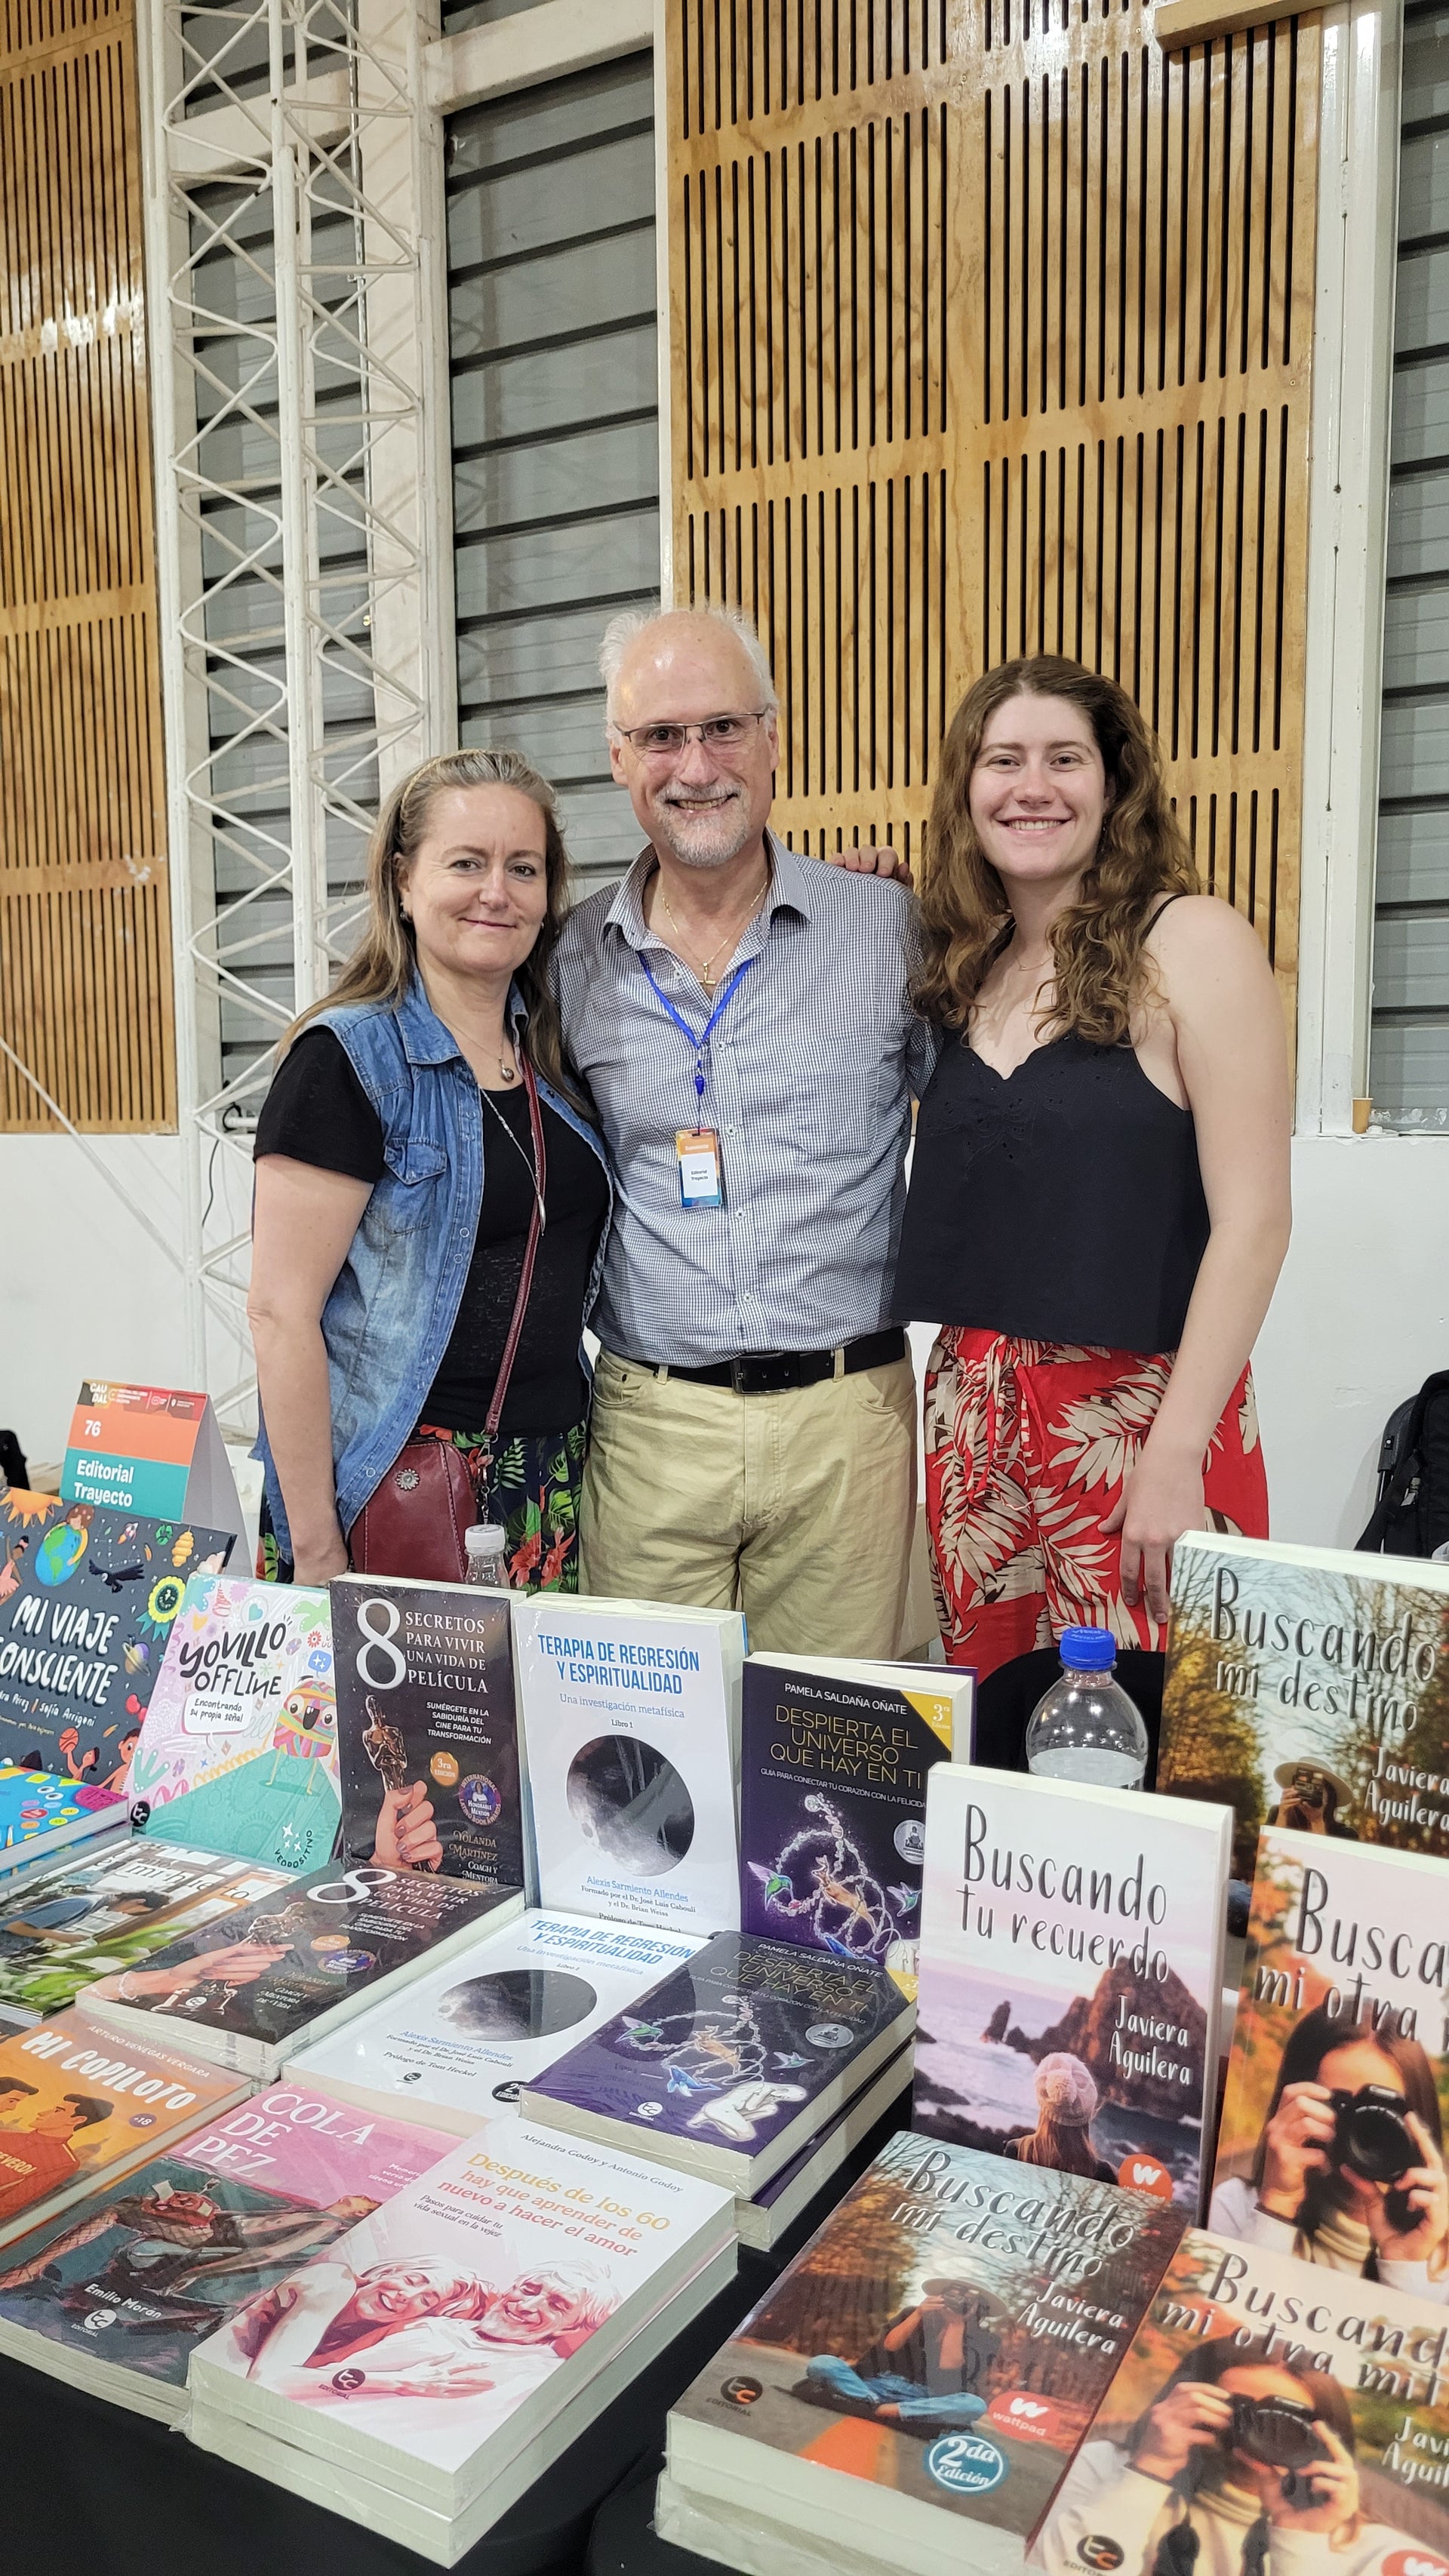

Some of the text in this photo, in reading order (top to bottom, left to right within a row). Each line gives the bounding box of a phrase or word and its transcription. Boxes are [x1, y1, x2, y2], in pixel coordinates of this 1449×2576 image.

[90, 1383, 107, 1393] CAU
[91, 1393, 108, 1404] DAL
[84, 1420, 101, 1437] 76
[76, 1459, 134, 1484] Editorial
[73, 1482, 133, 1508] Trayecto
[11, 1594, 119, 1655] MI VIAJE
[405, 1611, 485, 1635] SECRETOS
[1211, 1566, 1437, 1682] Buscando
[356, 1598, 406, 1690] 8
[406, 1632, 485, 1654] PARA VIVIR
[537, 1634, 700, 1672] TERAPIA DE REGRESIÓN
[0, 1636, 118, 1705] ONSCIENTE
[406, 1650, 486, 1671] UNA VIDA DE
[556, 1660, 682, 1694] Y ESPIRITUALIDAD
[408, 1669, 489, 1694] PELÍCULA
[1216, 1660, 1418, 1737] mi destino
[189, 1708, 244, 1723] su propia señal
[194, 1697, 242, 1713] Encontrando
[426, 1701, 489, 1717] SUMÉRGETE EN LA
[559, 1694, 685, 1719] Una investigación metafísica
[784, 1682, 908, 1716] PAMELA SALDAÑA OÑATE
[62, 1707, 97, 1729] Arrigoni
[432, 1711, 485, 1725] SABIDURÍA DEL
[435, 1721, 482, 1734] CINE PARA TU
[611, 1719, 628, 1728] Libro
[776, 1705, 918, 1750] DESPIERTA EL
[427, 1728, 491, 1744] TRANSFORMACIÓN
[791, 1727, 899, 1765] UNIVERSO
[437, 1758, 451, 1769] 3ra
[770, 1743, 921, 1790] QUE HAY EN TI
[1372, 1746, 1449, 1795] Javiera
[1364, 1780, 1449, 1831] Aguilera
[449, 1843, 498, 1861] MARTÍNEZ
[453, 1830, 497, 1848] YOLANDA
[462, 1870, 499, 1885] MENTORA
[468, 1860, 492, 1872] COACH
[963, 1803, 1167, 1925] Buscando
[306, 1868, 398, 1904] 8
[371, 1890, 460, 1911] UNA VIDA DE
[383, 1885, 469, 1905] PARA VIVIR
[395, 1877, 483, 1898] SECRETOS
[358, 1897, 447, 1920] PELÍCULA
[530, 1919, 697, 1959] TERAPIA DE REGRESIÓN
[533, 1932, 663, 1965] Y ESPIRITUALIDAD
[956, 1883, 1169, 1983] tu recuerdo
[733, 1950, 878, 1995] DESPIERTA EL
[758, 1943, 884, 1978] PAMELA SALDAÑA OÑATE
[710, 1966, 868, 2012] QUE HAY EN TI
[742, 1963, 854, 1996] UNIVERSO
[1254, 1965, 1417, 2041] mi otra
[1115, 1994, 1189, 2048] Javiera
[88, 2025, 211, 2079] ARTURO VENEGAS VERGARA
[1109, 2030, 1192, 2086] Aguilera
[21, 2031, 196, 2110] MI COPILOTO
[134, 2115, 152, 2127] +18
[219, 2112, 293, 2147] DE
[261, 2092, 379, 2147] COLA
[183, 2134, 278, 2178] PEZ
[520, 2132, 567, 2153] Alejandra
[568, 2149, 599, 2165] Godoy
[608, 2162, 649, 2181] Antonio
[649, 2176, 684, 2193] Godoy
[459, 2169, 643, 2242] hay que aprender de
[466, 2152, 672, 2232] Después de los 60
[904, 2150, 1136, 2248] Buscando
[414, 2202, 431, 2212] vida
[430, 2208, 460, 2222] sexual
[469, 2221, 479, 2230] la
[480, 2227, 502, 2238] vejez
[420, 2194, 445, 2208] Pasos
[443, 2204, 464, 2215] para
[465, 2212, 493, 2225] cuidar
[437, 2181, 638, 2257] nuevo a hacer el amor
[891, 2202, 1104, 2283] mi destino
[84, 2282, 163, 2319] Emilio Morán
[1037, 2280, 1124, 2328] Javiera
[71, 2323, 100, 2338] EDITORIAL
[1017, 2303, 1117, 2355] Aguilera
[1161, 2302, 1335, 2375] mi otra
[318, 2384, 351, 2400] EDITORIAL
[706, 2396, 752, 2417] EDITORIAL
[992, 2410, 1047, 2438] wattpad
[939, 2435, 998, 2467] 2da
[936, 2464, 990, 2486] Edición
